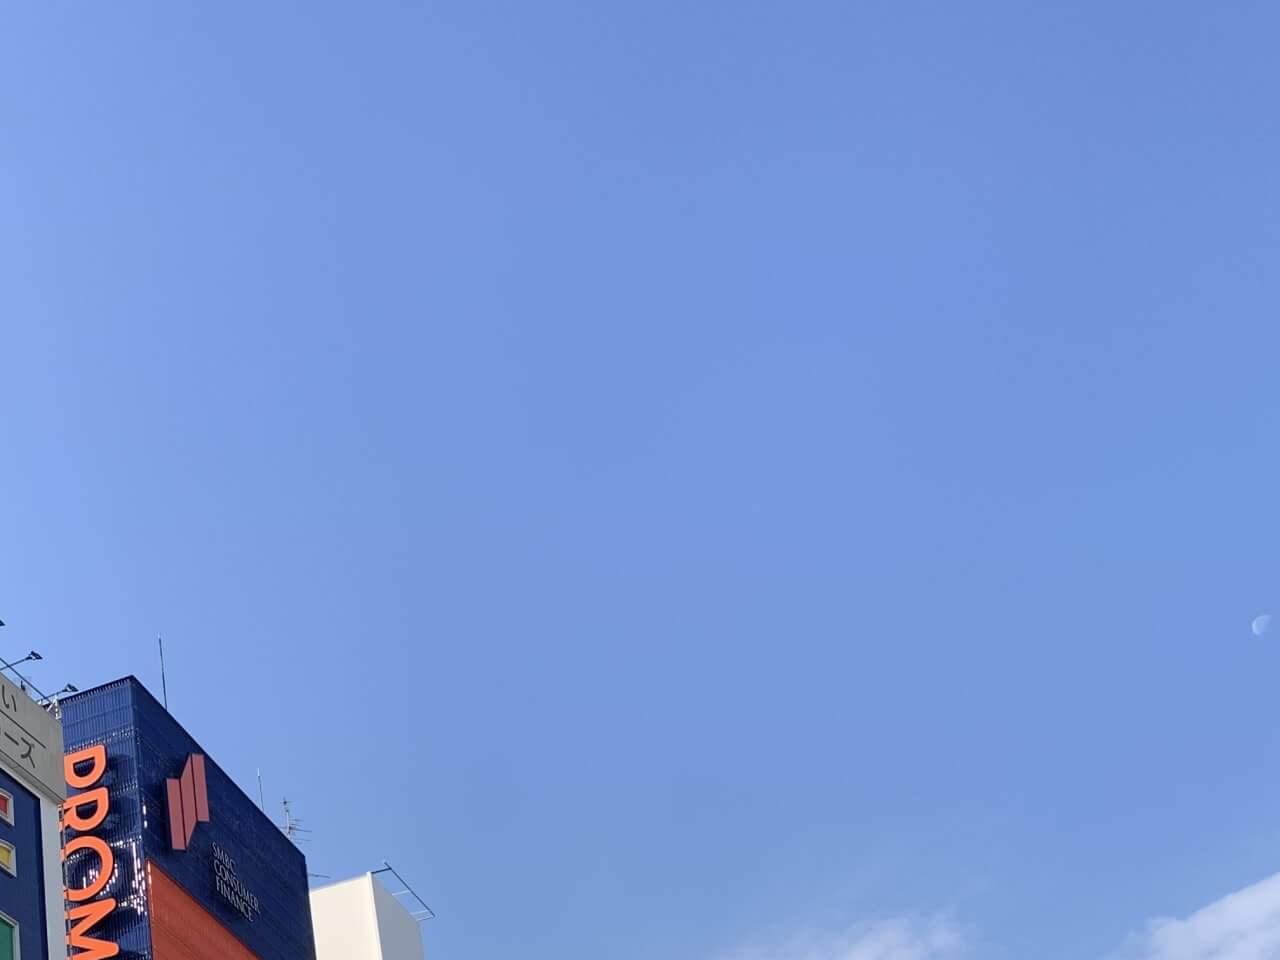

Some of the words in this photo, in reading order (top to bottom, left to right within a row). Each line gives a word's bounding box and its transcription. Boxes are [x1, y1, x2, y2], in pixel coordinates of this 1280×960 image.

[211, 841, 237, 875] SMBC
[213, 859, 261, 914] CONSUMER
[215, 875, 255, 922] FINANCE
